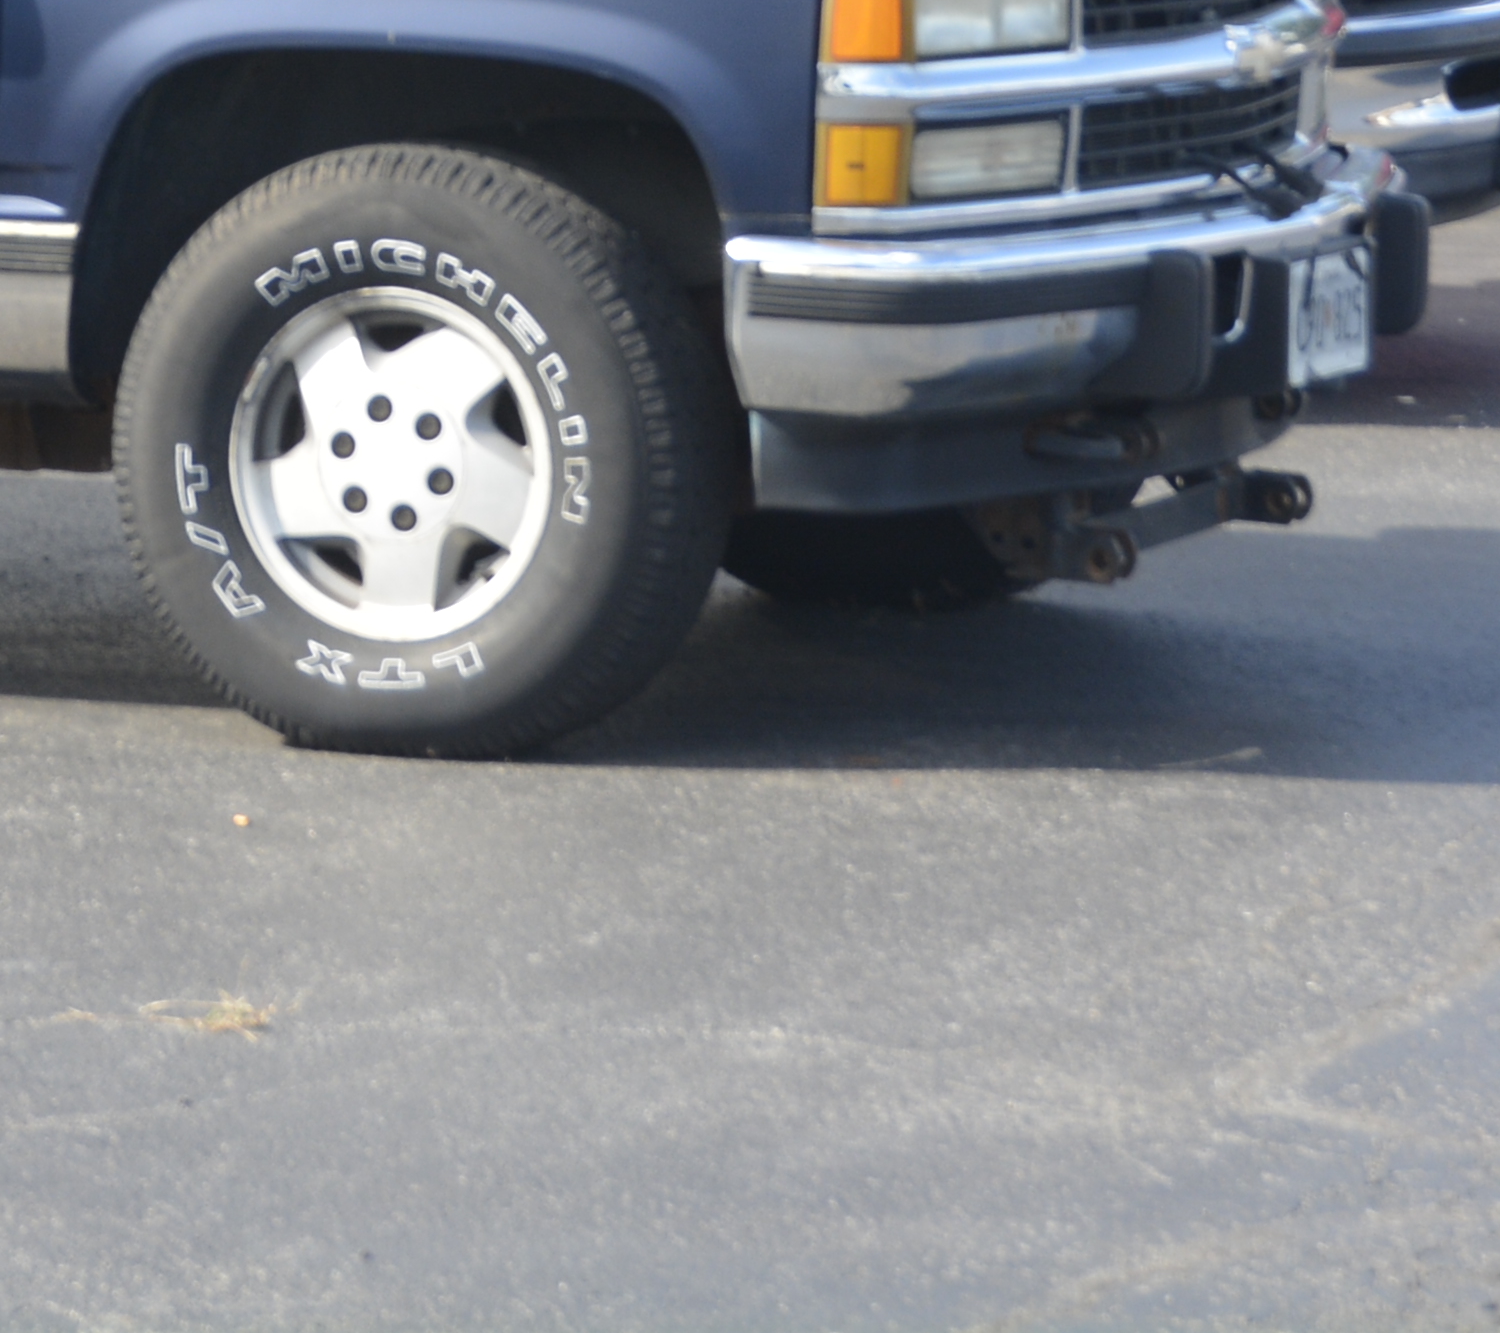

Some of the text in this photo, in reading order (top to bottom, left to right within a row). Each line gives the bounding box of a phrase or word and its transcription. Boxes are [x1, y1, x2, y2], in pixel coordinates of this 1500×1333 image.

[255, 238, 590, 525] MICHELIN
[174, 443, 485, 688] LTX A/T
